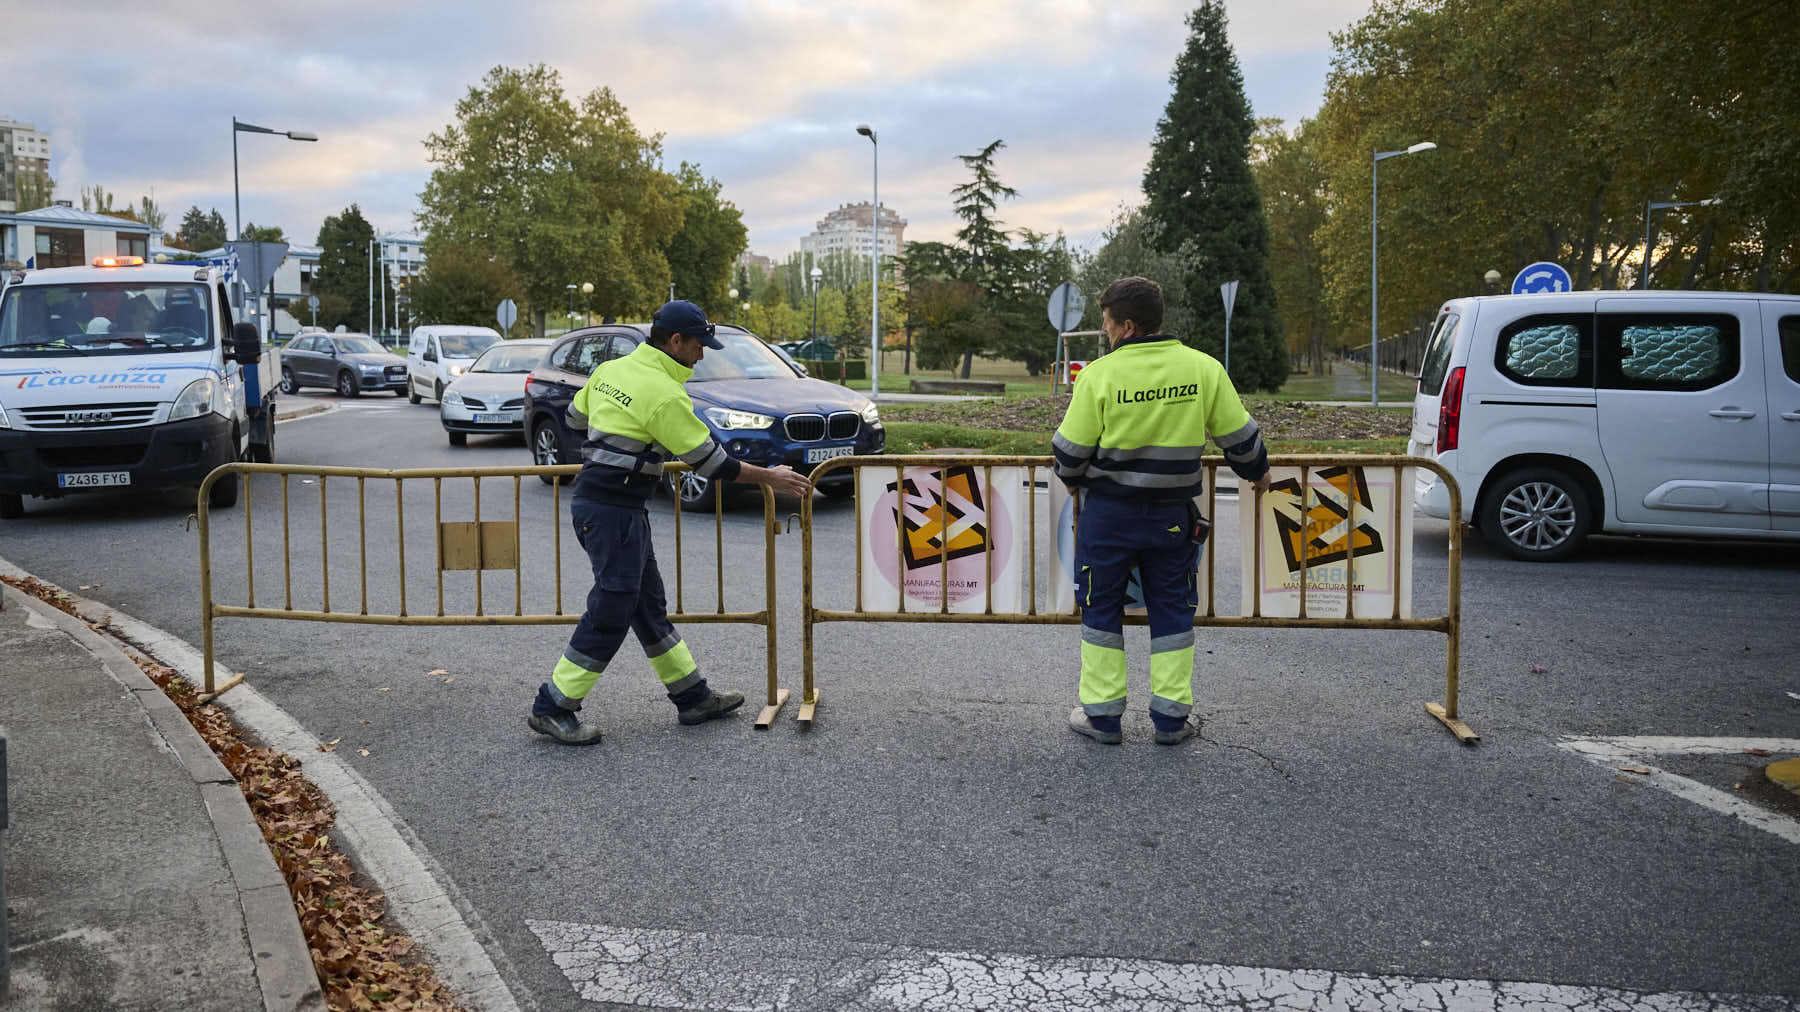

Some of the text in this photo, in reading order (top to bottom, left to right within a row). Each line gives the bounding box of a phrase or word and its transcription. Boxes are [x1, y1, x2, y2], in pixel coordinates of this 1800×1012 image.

[64, 411, 113, 424] IVECO
[67, 473, 127, 486] 2436 FYG
[1353, 584, 1365, 592] MT
